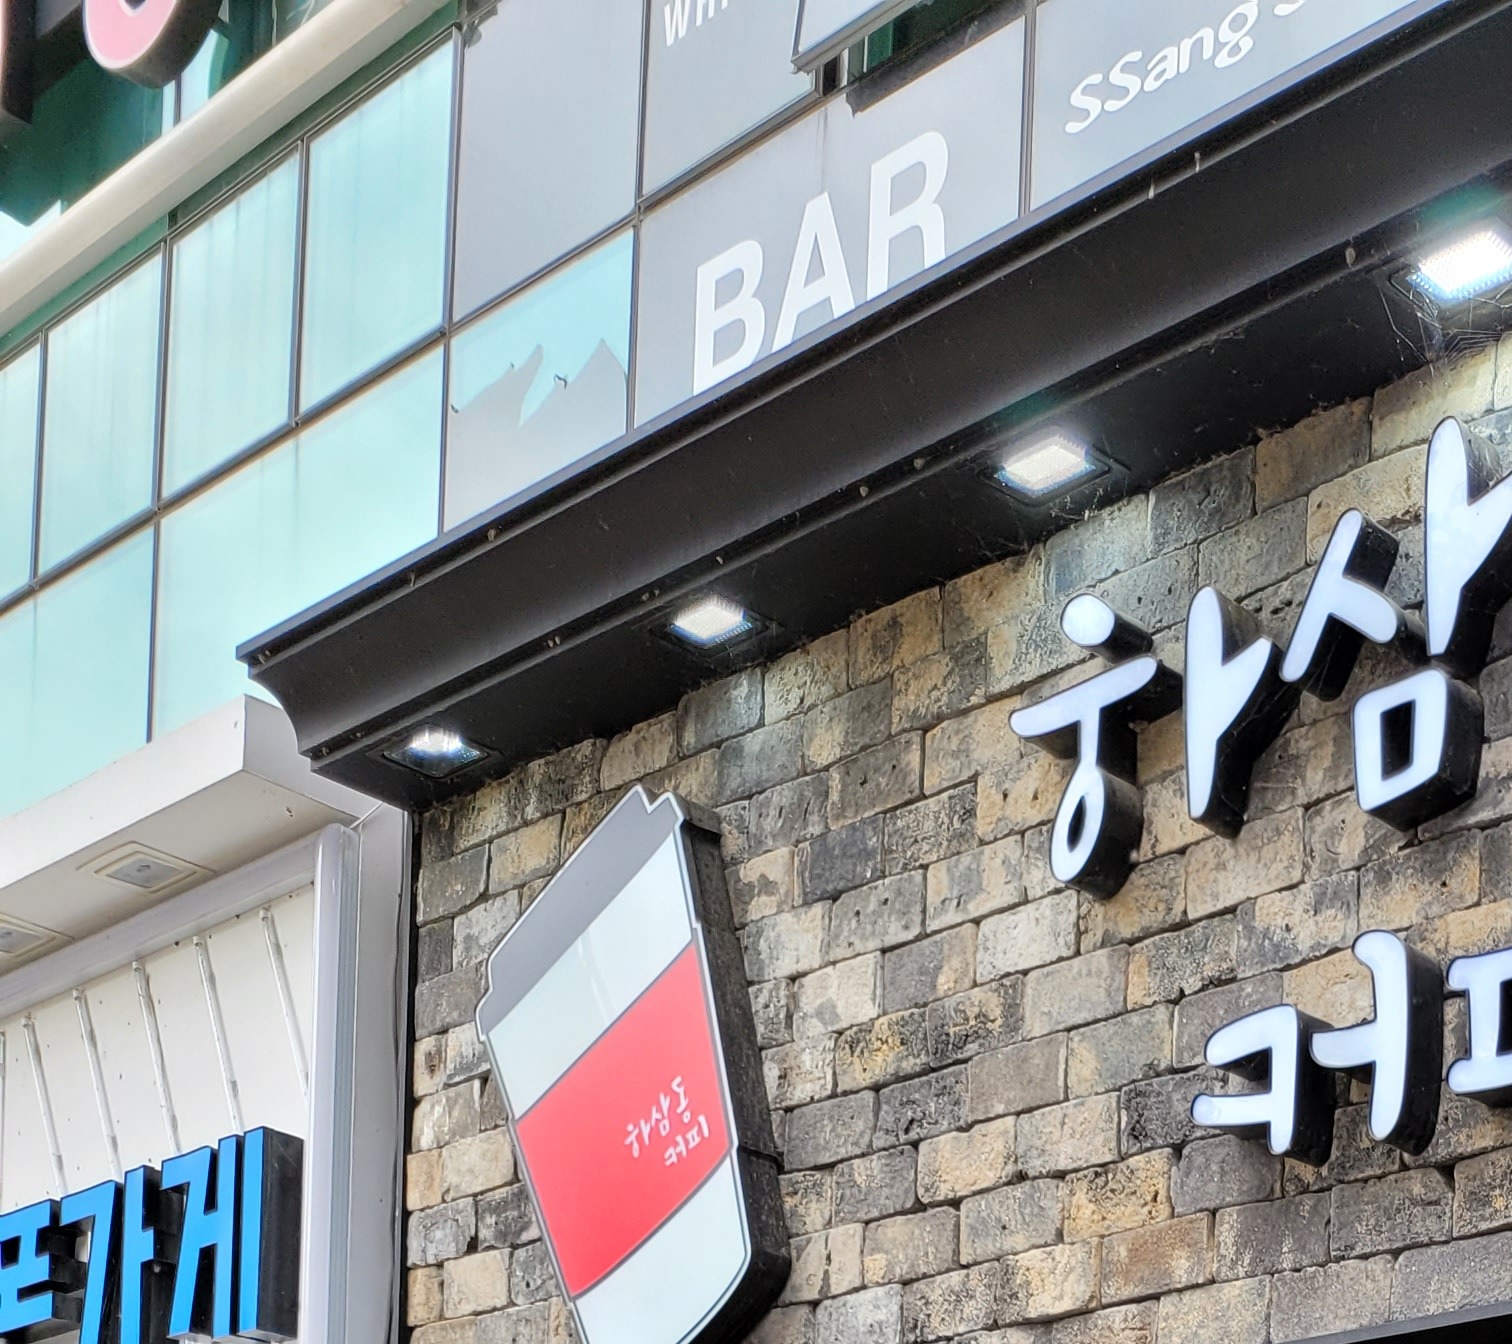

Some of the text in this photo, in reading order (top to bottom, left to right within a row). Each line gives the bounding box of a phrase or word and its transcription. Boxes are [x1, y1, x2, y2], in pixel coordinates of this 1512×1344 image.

[692, 130, 949, 397] BAR
[623, 1075, 692, 1159] 하삼동
[663, 1113, 710, 1167] 커피
